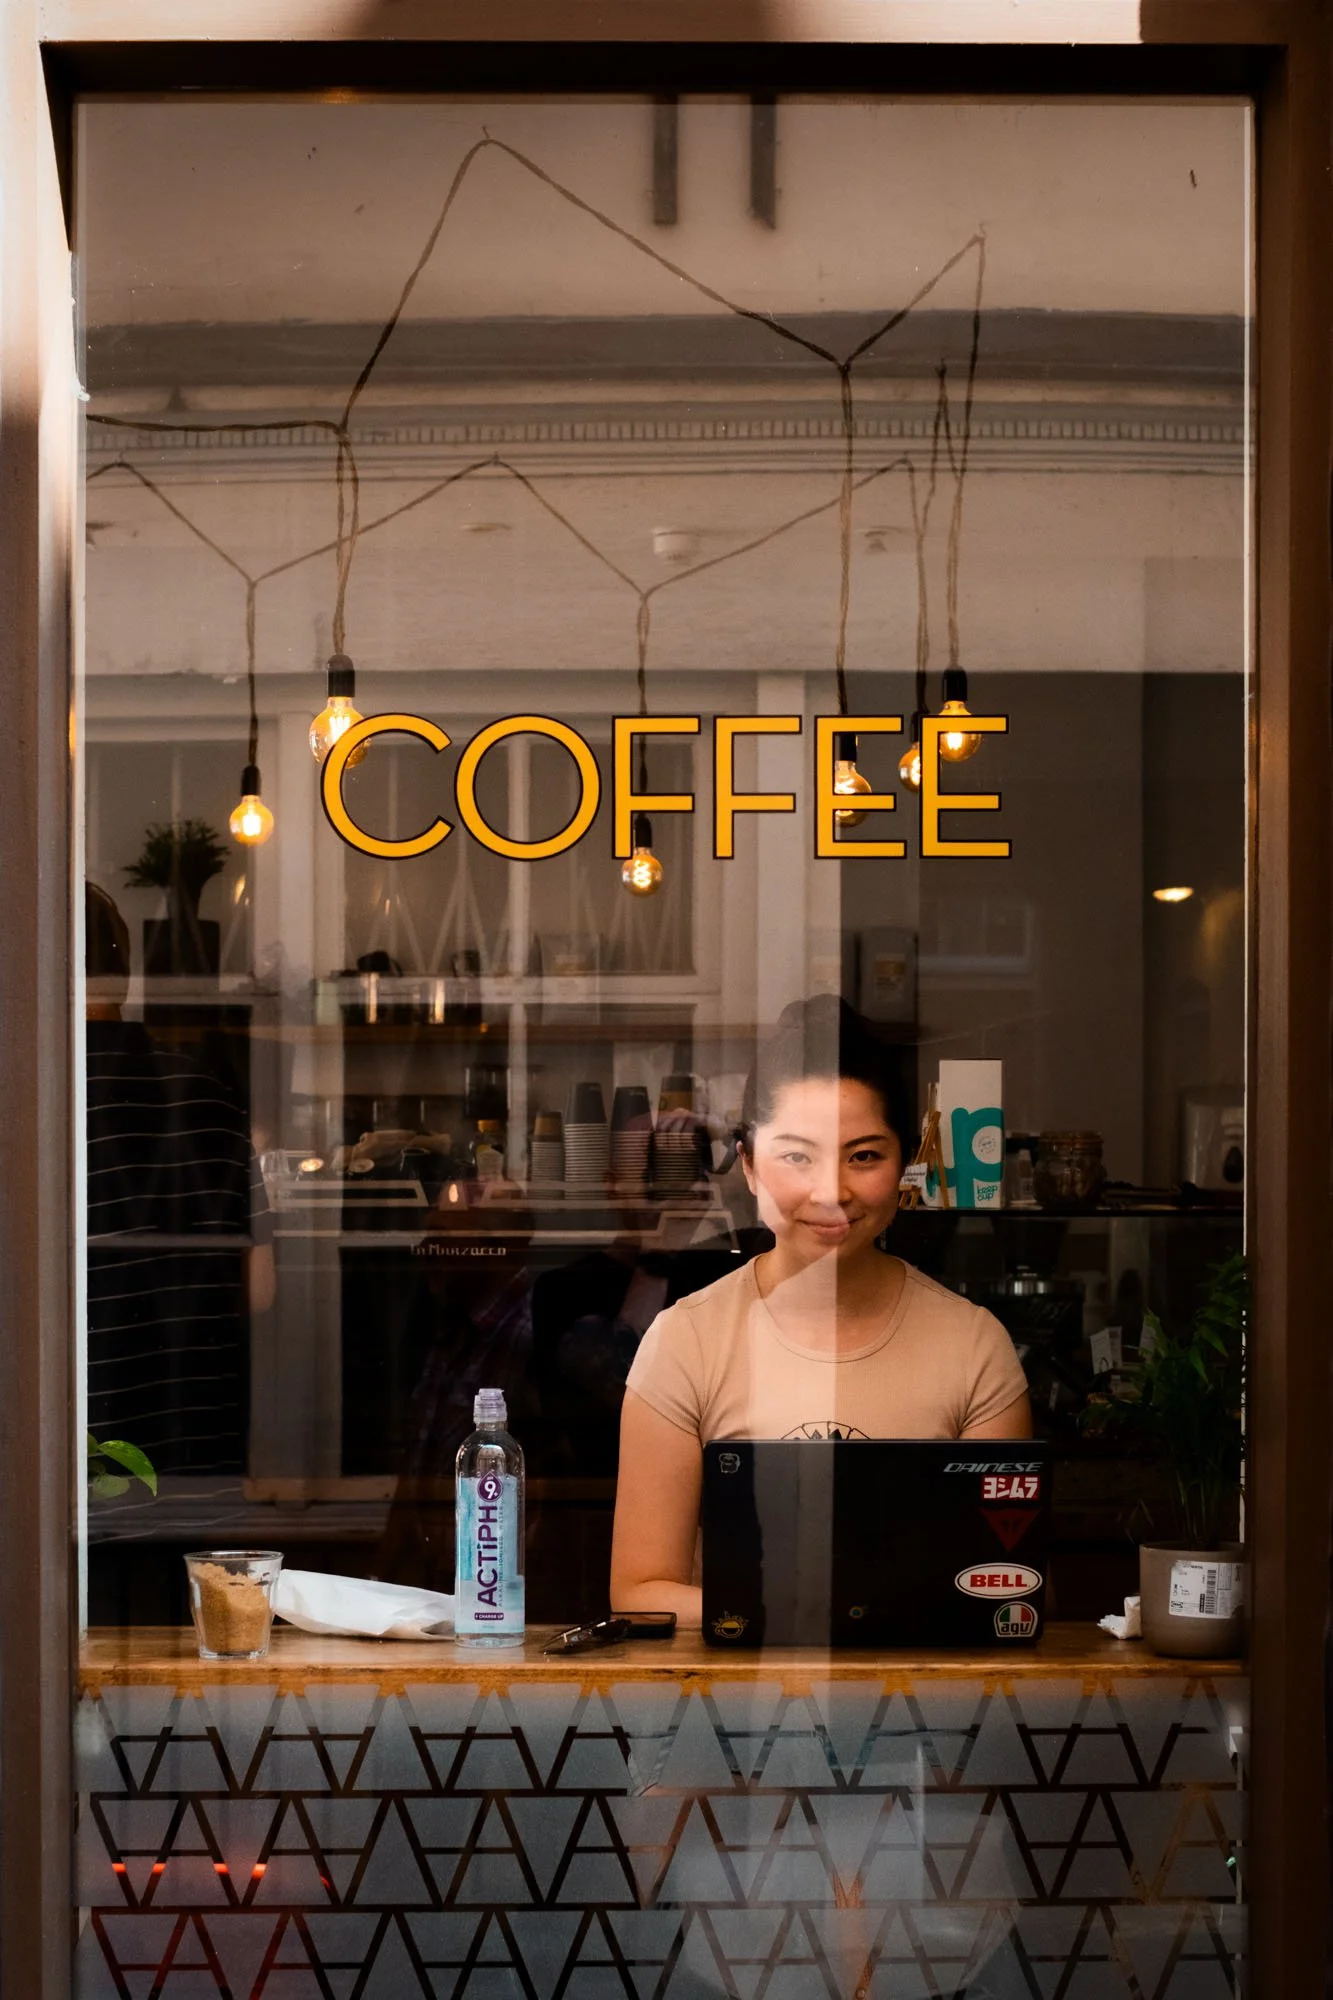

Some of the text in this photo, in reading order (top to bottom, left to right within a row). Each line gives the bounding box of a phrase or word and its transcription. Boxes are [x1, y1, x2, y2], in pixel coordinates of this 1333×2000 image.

[320, 713, 1012, 860] COFFEE
[977, 1192, 994, 1201] cup
[943, 1461, 1044, 1473] DAINESE
[983, 1477, 1038, 1499] ヨシムラ
[969, 1574, 1028, 1588] BELL
[1000, 1622, 1030, 1635] agv
